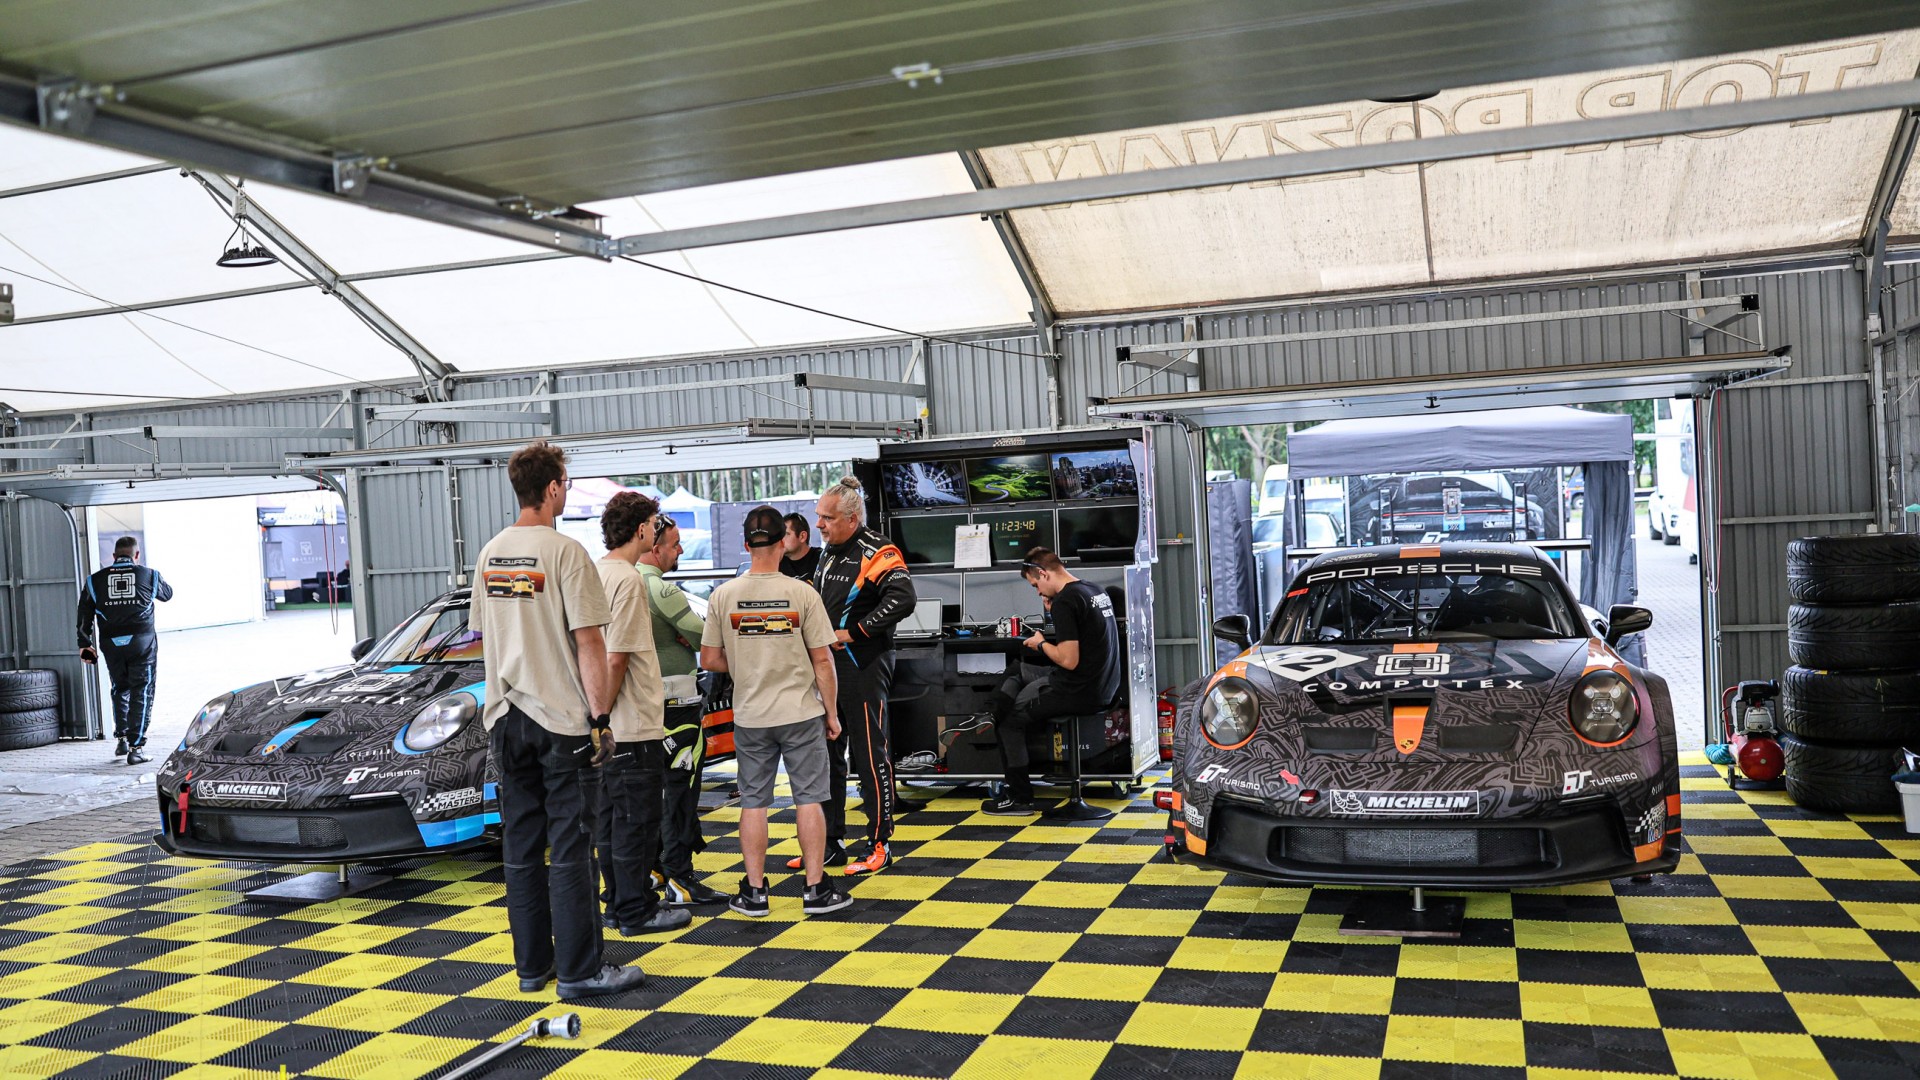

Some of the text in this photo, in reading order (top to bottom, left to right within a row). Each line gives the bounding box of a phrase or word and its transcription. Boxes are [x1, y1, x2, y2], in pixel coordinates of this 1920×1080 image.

[996, 520, 1036, 532] 11:23:48
[1307, 563, 1542, 584] PORSCHE
[1302, 678, 1525, 693] COMPUTEX
[266, 695, 413, 706] COMPUTEX
[371, 769, 421, 779] TURISMO
[1589, 772, 1638, 787] TURISMO
[216, 783, 281, 796] MICHELIN
[878, 762, 891, 813] COMPUTEX
[1219, 776, 1261, 791] TURISMO
[440, 787, 476, 801] SPEED
[437, 792, 483, 811] MASTERS
[1366, 796, 1470, 809] MICHELIN
